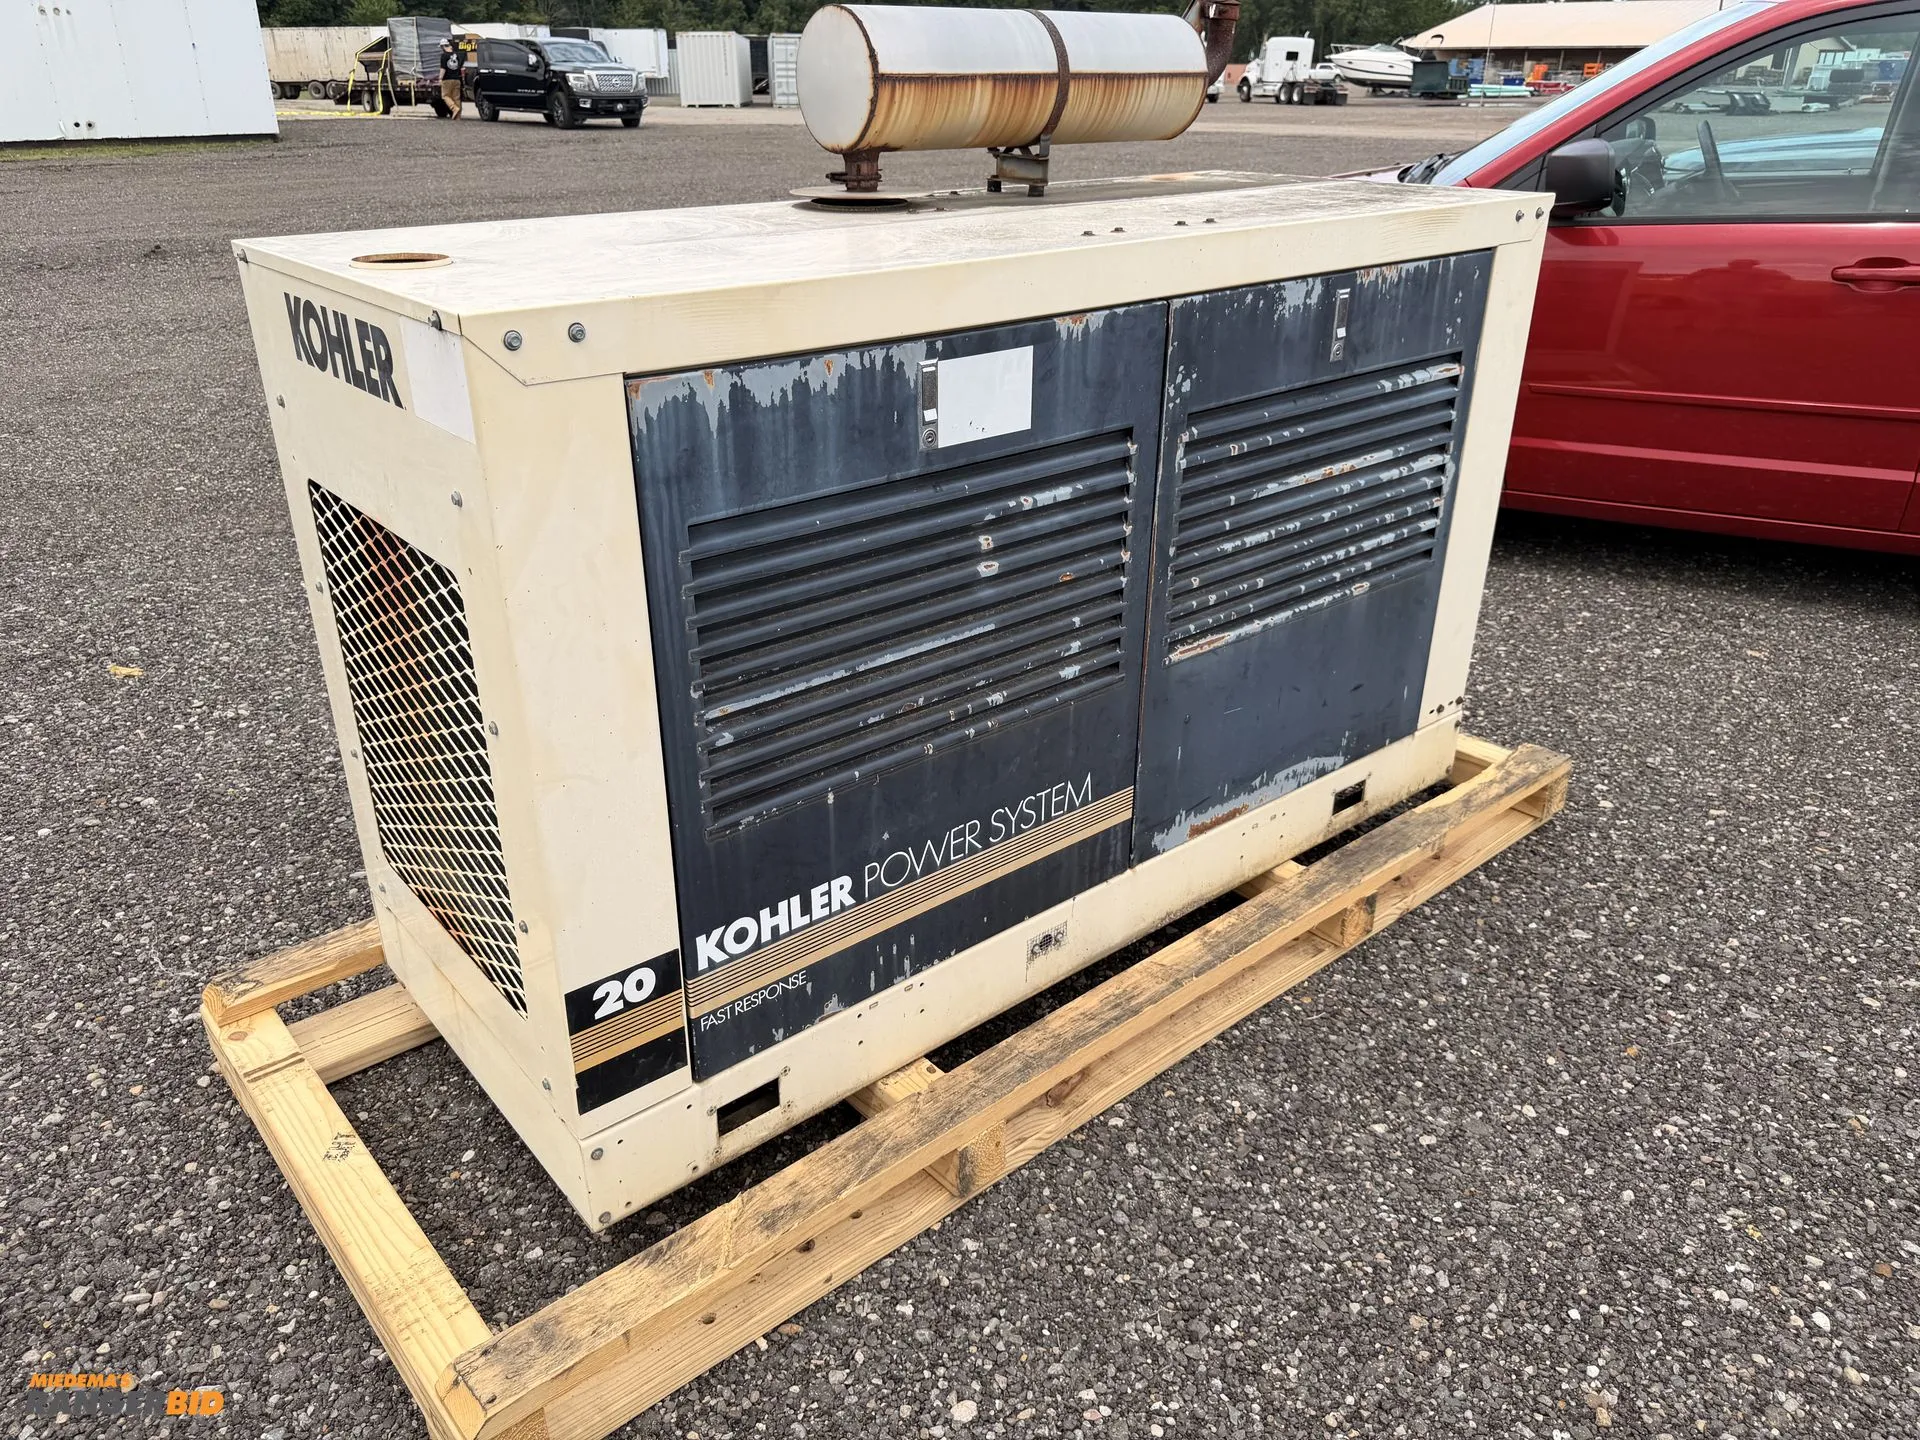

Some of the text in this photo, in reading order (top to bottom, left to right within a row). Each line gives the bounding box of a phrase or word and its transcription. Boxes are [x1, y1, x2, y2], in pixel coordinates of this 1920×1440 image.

[283, 292, 405, 409] KOHLER
[695, 771, 1092, 971] KOHLER POWER SYSTEM
[592, 967, 656, 1020] 20
[700, 970, 807, 1032] FAST RESPONSE
